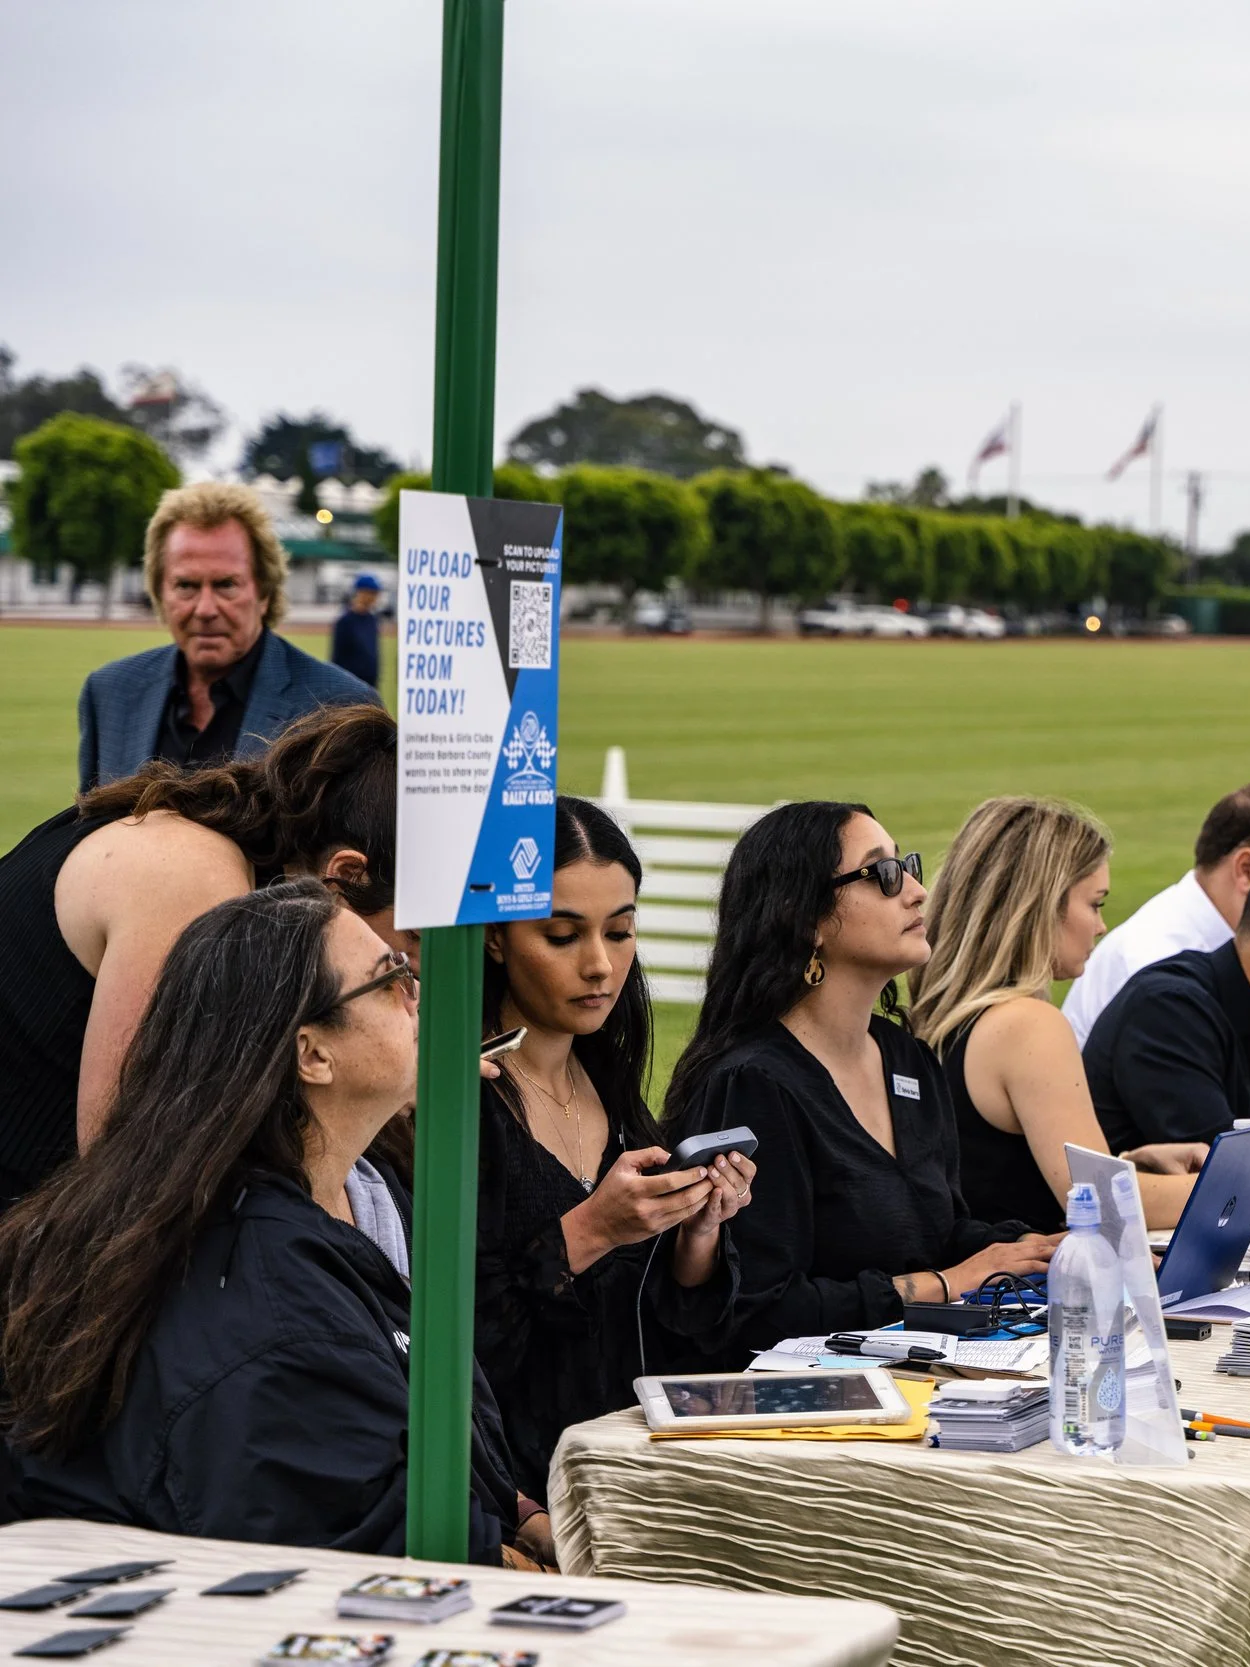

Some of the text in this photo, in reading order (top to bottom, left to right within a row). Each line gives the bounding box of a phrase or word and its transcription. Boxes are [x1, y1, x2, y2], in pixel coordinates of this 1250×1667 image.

[503, 544, 560, 560] SCAN TO UPLOAD
[408, 549, 472, 578] UPLOAD
[506, 559, 524, 572] YOUR
[408, 585, 451, 611] YOUR
[406, 619, 485, 647] PICTURES
[406, 654, 452, 680] FROM
[406, 688, 465, 715] TODAY!
[405, 733, 493, 746] United Boys & Girls Clubs
[405, 750, 491, 762] of Santa Barbara County
[405, 768, 489, 779] wants you to share your
[405, 784, 440, 794] memories
[442, 782, 458, 793] from
[460, 784, 471, 793] the
[502, 789, 554, 806] RALLY 4 KIDS
[1090, 1335, 1124, 1348] PURE
[1098, 1346, 1121, 1354] WATER
